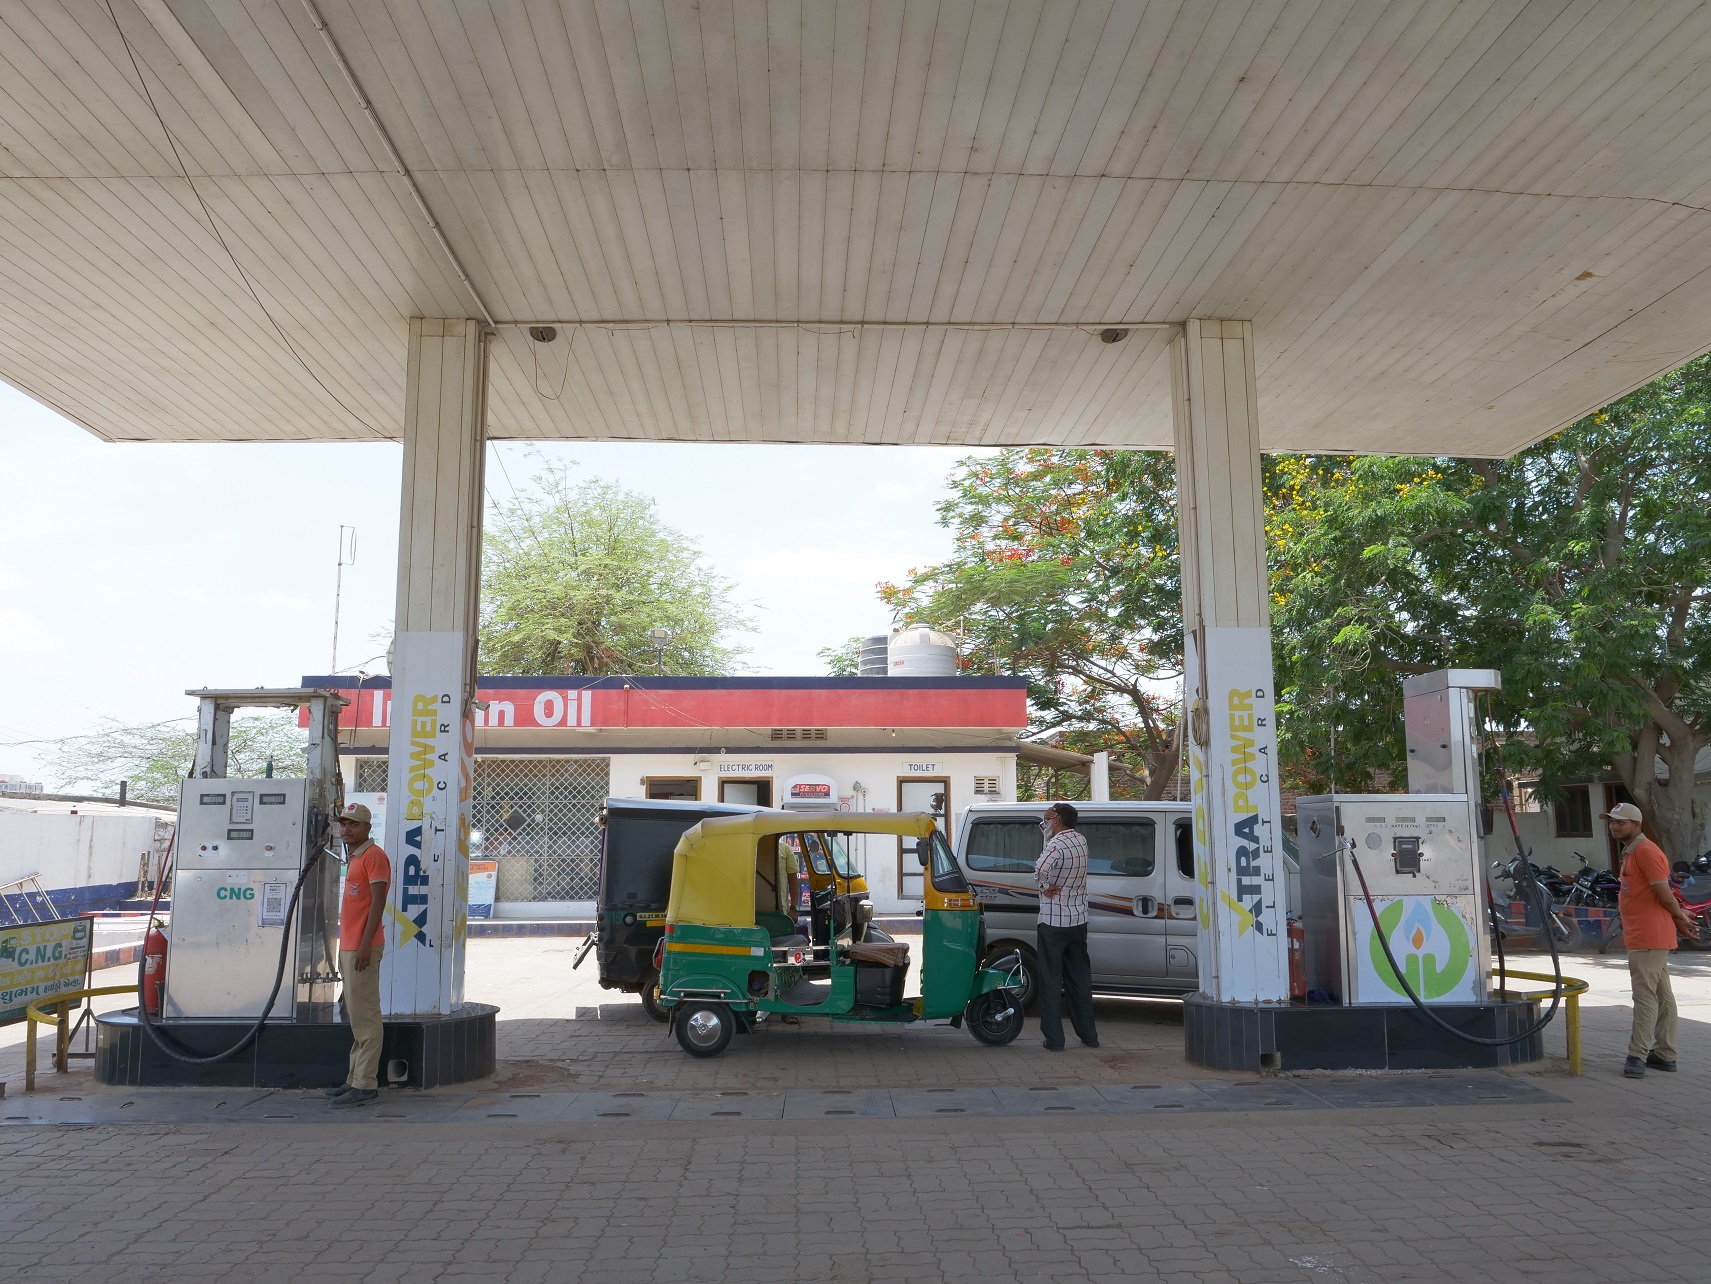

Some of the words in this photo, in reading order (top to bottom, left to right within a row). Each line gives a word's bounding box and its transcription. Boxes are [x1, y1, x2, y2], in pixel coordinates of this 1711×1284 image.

[533, 690, 592, 727] Oil
[436, 693, 452, 791] CARD
[1255, 688, 1270, 784] CARD
[719, 763, 753, 772] ELECTRIC
[755, 763, 773, 772] ROOM
[908, 763, 936, 772] TOILET
[799, 784, 829, 792] SERVO
[1221, 687, 1264, 938] XTRAPOWER
[1261, 818, 1277, 937] FLEET
[216, 886, 255, 901] CNG
[20, 925, 70, 945] STOP
[17, 942, 68, 968] C.N.G.
